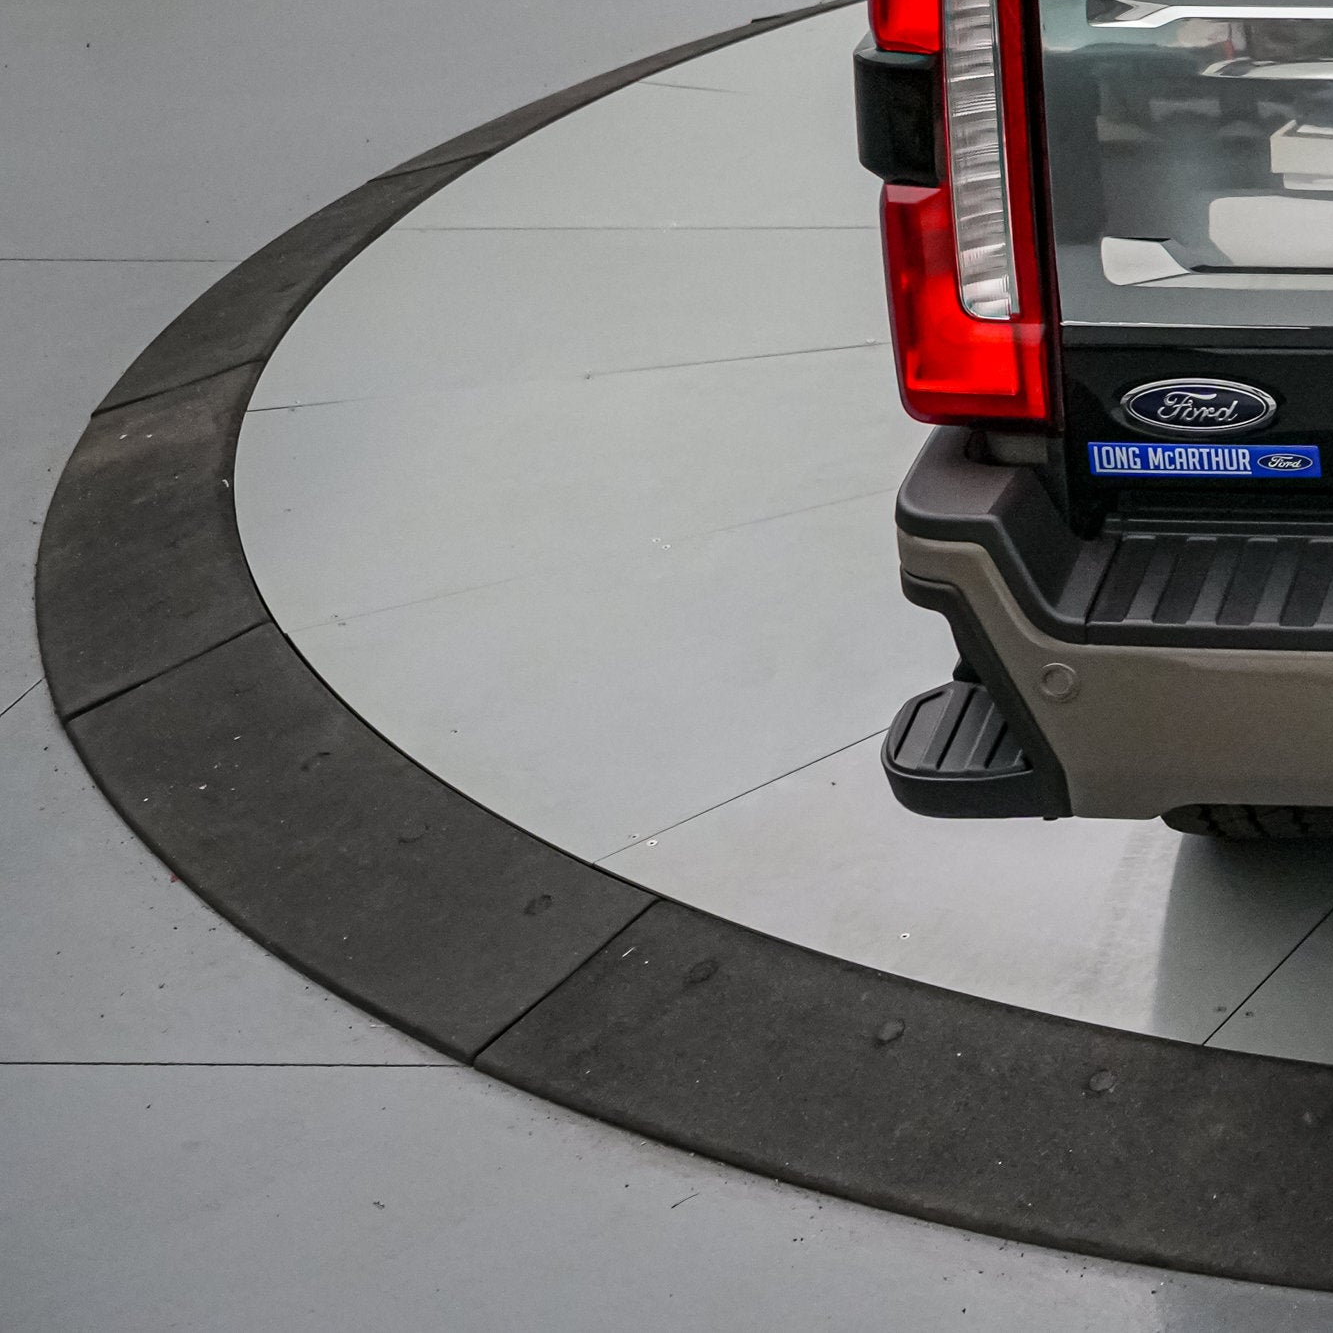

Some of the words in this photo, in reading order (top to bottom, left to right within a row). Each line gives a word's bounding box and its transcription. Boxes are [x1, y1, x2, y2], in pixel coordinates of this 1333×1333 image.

[1157, 391, 1240, 422] Ford
[1093, 446, 1141, 472] LONG
[1148, 448, 1252, 471] McARTHUR
[1267, 456, 1303, 469] Ford
